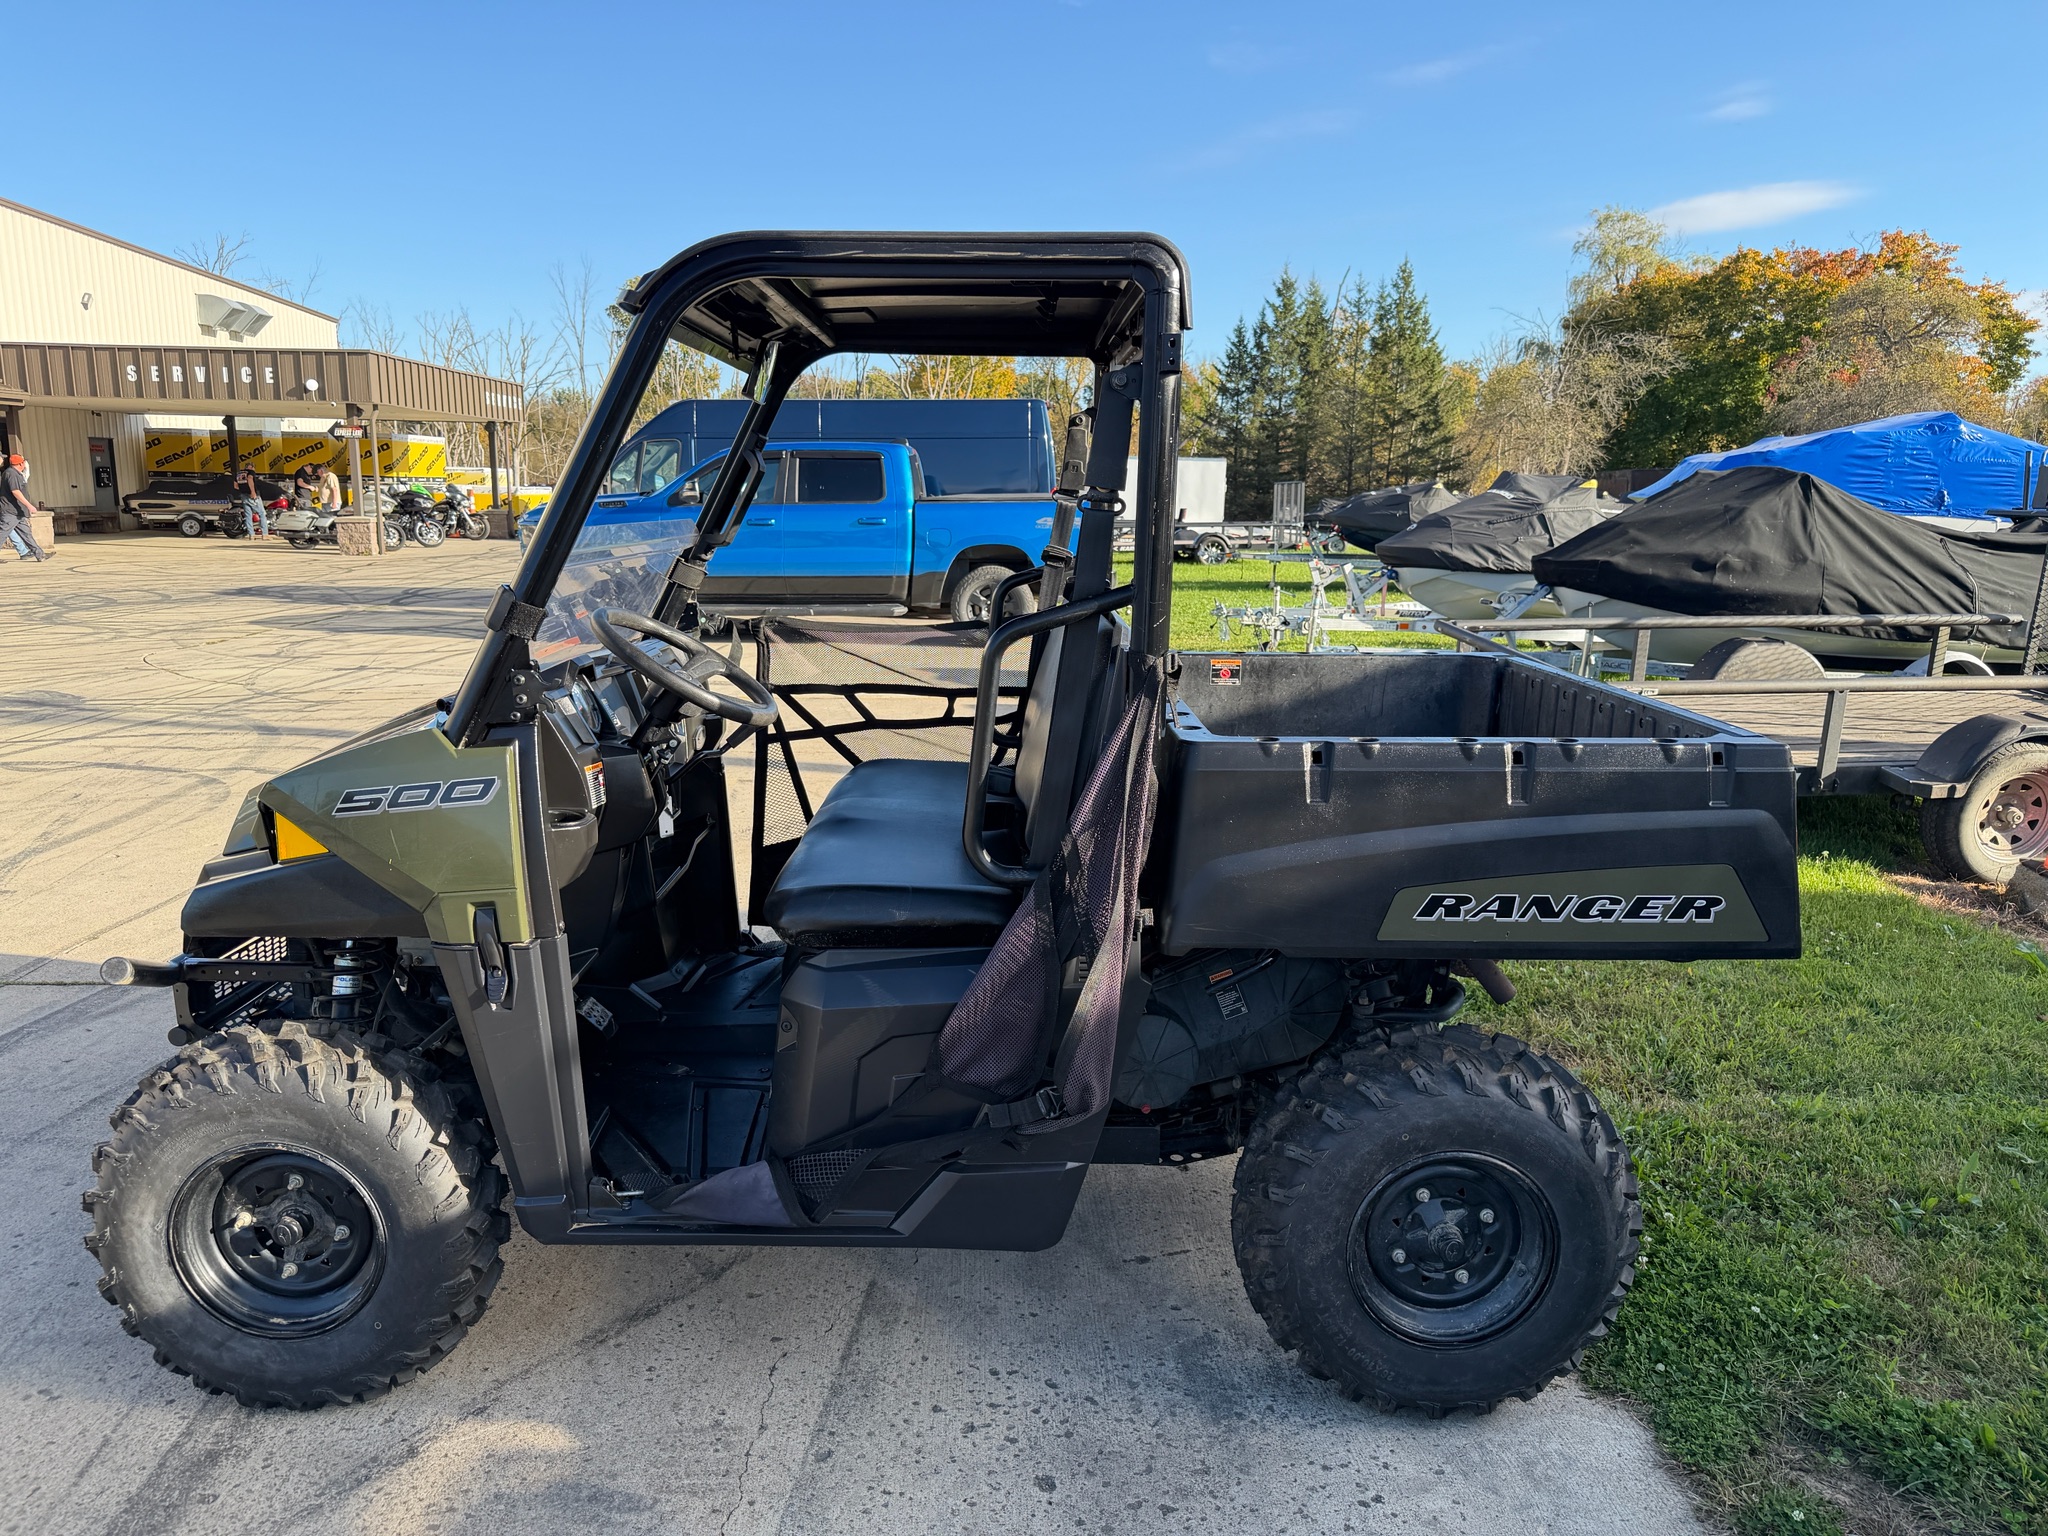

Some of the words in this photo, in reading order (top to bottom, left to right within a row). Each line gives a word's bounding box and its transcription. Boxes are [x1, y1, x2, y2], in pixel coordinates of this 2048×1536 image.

[126, 364, 275, 384] SERVICE
[331, 776, 501, 818] 500
[1413, 893, 1726, 923] RANGER
